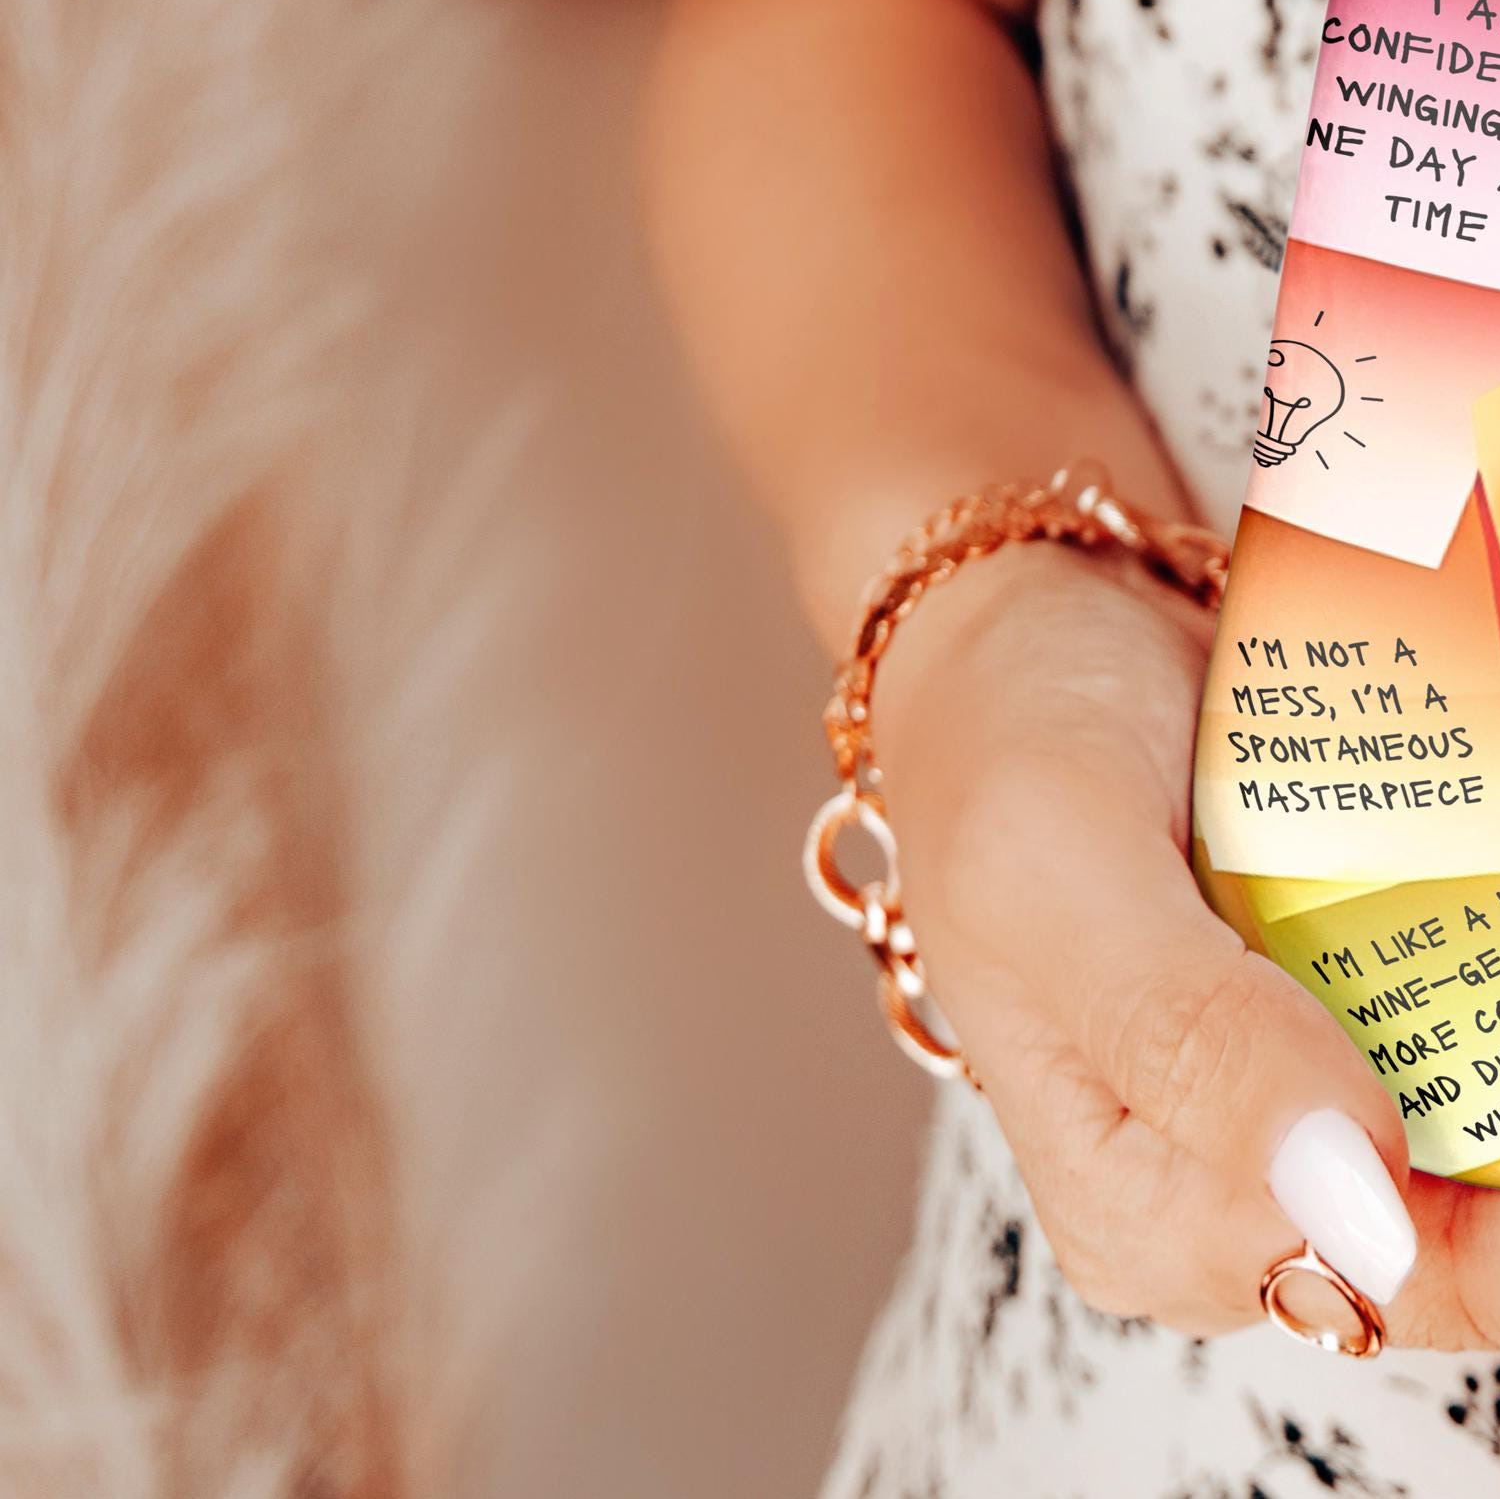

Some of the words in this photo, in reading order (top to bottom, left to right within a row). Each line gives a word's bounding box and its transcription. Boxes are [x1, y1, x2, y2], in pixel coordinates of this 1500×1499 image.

[1389, 135, 1477, 187] DAY
[1385, 194, 1488, 242] TIME
[1237, 637, 1288, 670] I'M
[1305, 641, 1370, 668] NOT
[1394, 637, 1418, 667] A
[1231, 685, 1337, 722] MESS,
[1351, 683, 1403, 715] I'M
[1424, 683, 1449, 713] A
[1227, 726, 1474, 765] SPONTANEOUS
[1238, 775, 1484, 813] MASTERPIECE
[1311, 946, 1364, 985] I'M
[1370, 916, 1447, 967] LIKE
[1463, 904, 1491, 933] A
[1368, 1019, 1458, 1076] MORE
[1399, 1074, 1462, 1119] AND
